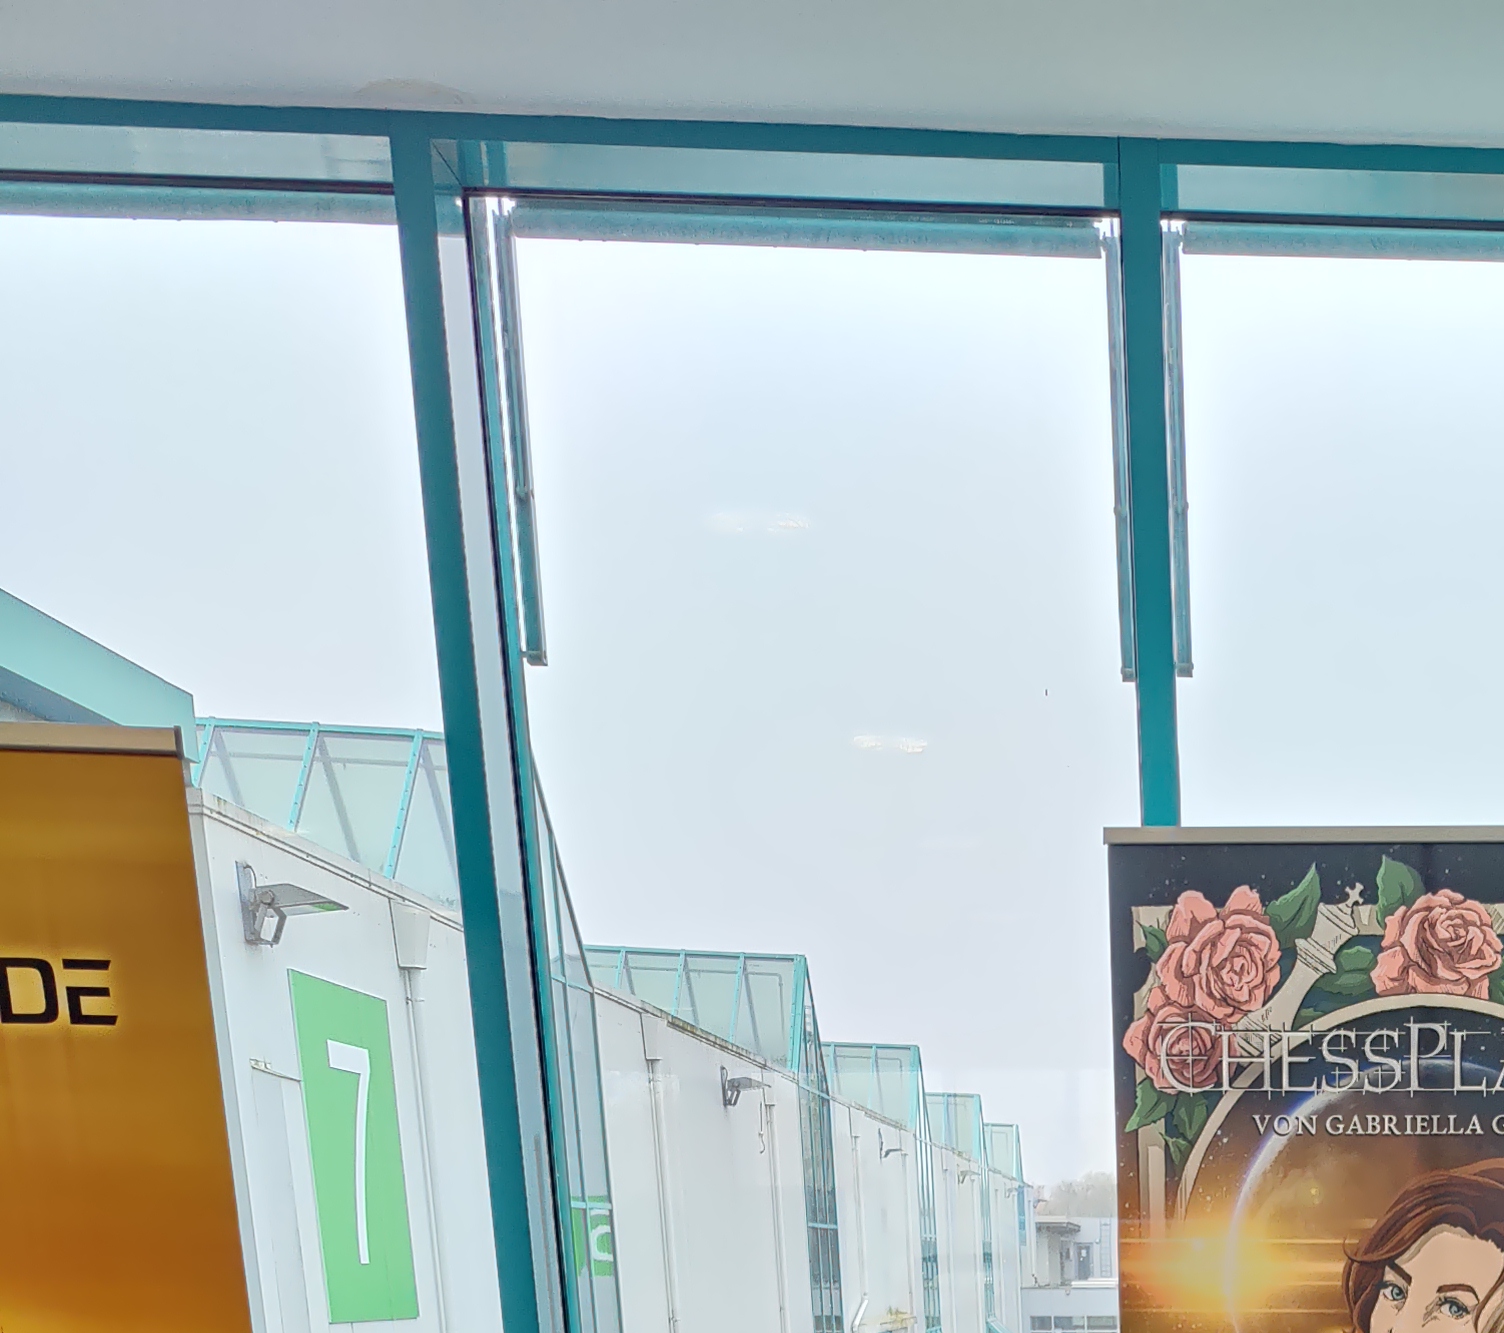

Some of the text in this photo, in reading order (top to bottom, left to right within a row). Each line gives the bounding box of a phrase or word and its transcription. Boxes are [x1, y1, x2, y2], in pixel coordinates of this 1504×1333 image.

[326, 1038, 371, 1265] 7
[1252, 1114, 1318, 1137] VON
[1325, 1113, 1480, 1137] GABRIELLA
